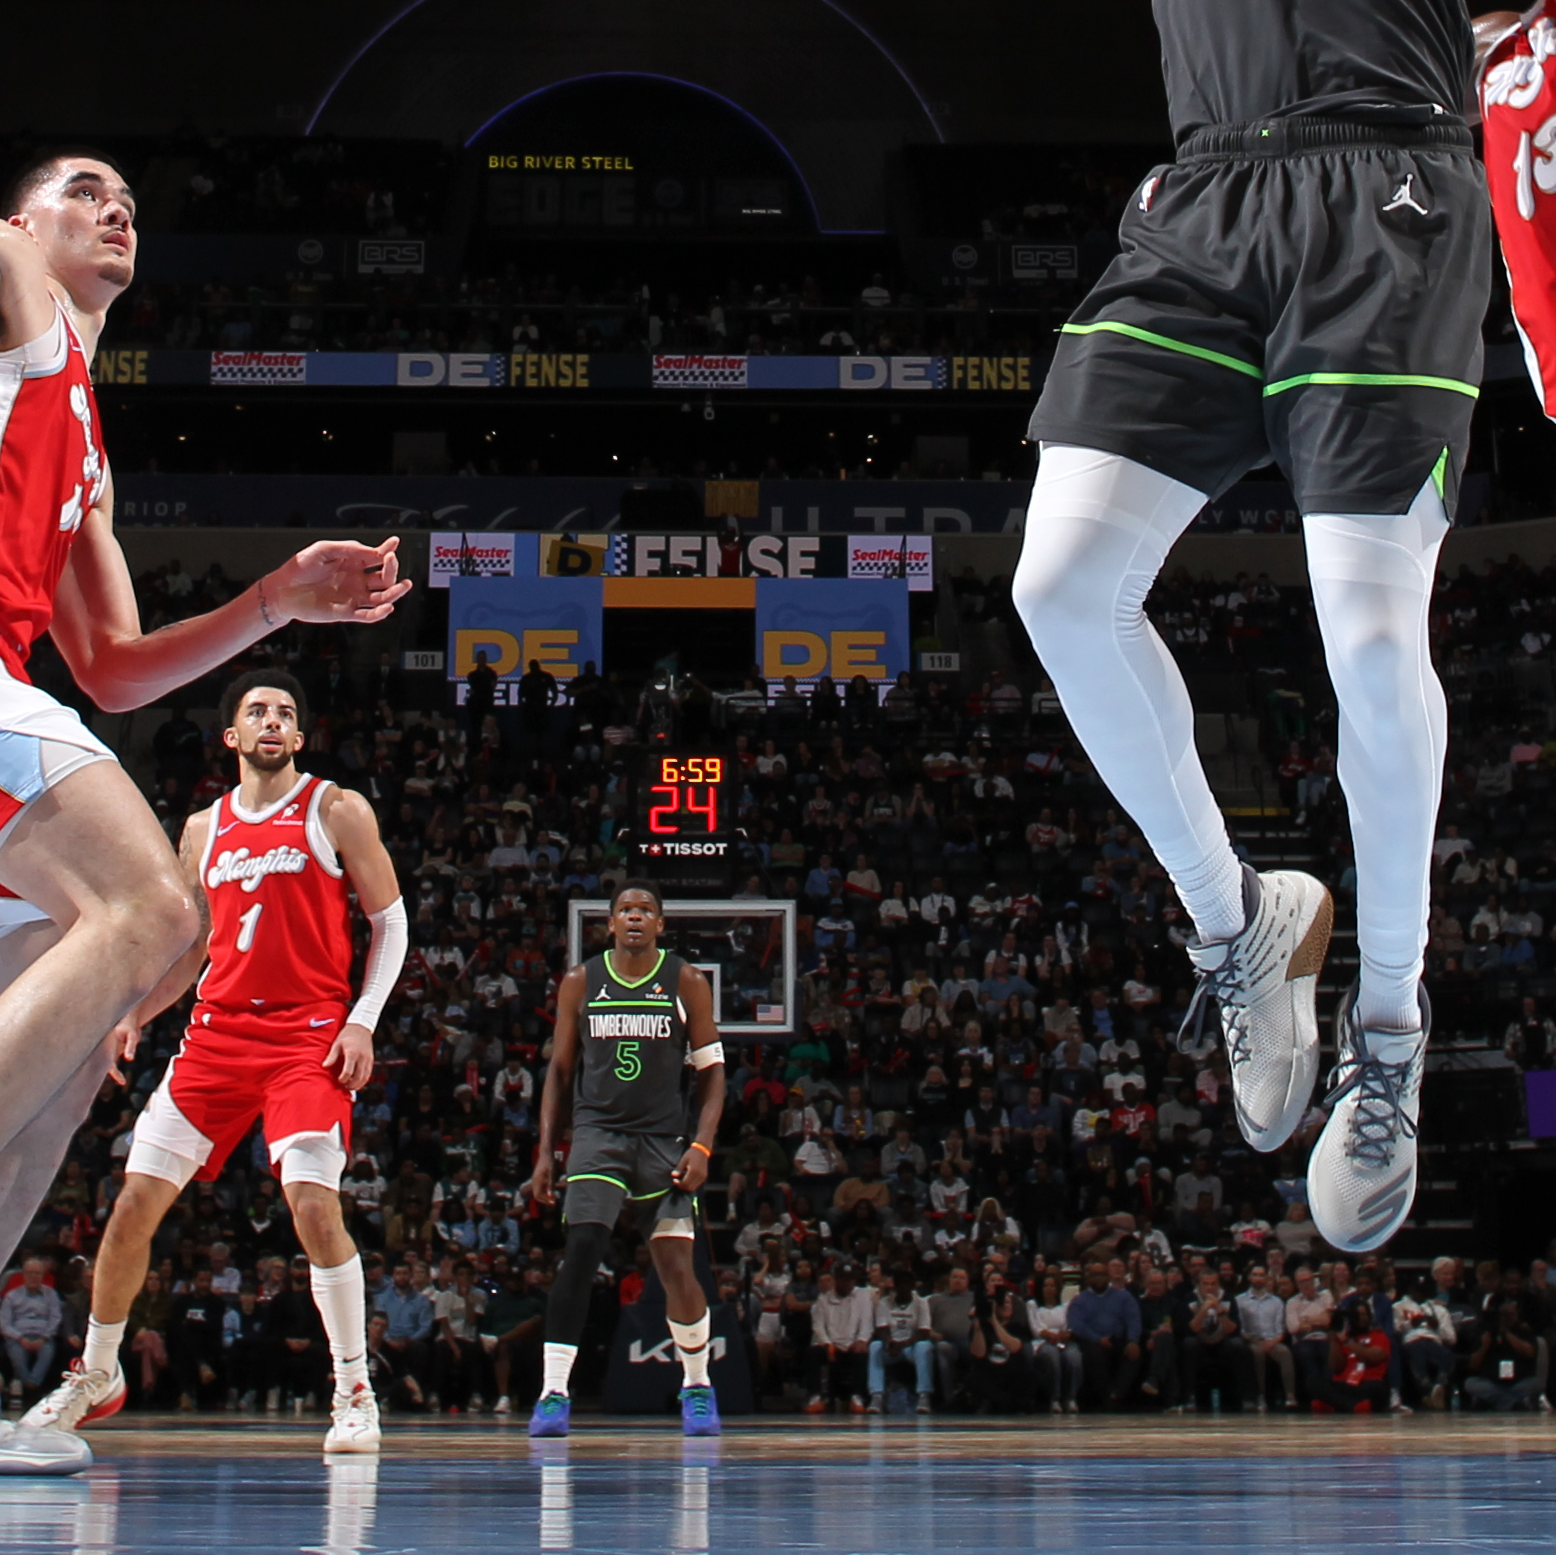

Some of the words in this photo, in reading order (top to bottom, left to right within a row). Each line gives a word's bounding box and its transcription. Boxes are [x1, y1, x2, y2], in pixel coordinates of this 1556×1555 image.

[488, 155, 518, 169] BIG
[524, 155, 576, 169] RIVER
[581, 156, 634, 170] STEEL
[365, 246, 419, 262] BRS
[1017, 251, 1073, 267] BRS
[212, 351, 304, 367] SealMaster
[398, 353, 490, 387] DE
[509, 353, 591, 388] FENSE
[652, 354, 746, 371] SealMaster
[840, 356, 933, 390] DE
[952, 356, 1032, 391] FENSE
[556, 545, 592, 575] D
[413, 653, 436, 667] 101
[455, 629, 579, 677] DE
[761, 631, 887, 678] DE
[928, 654, 953, 668] 118
[661, 758, 722, 784] 6:59
[649, 785, 718, 833] 24
[663, 843, 728, 856] TISSOT
[208, 845, 309, 893] Memphis
[237, 902, 263, 953] 1
[587, 1013, 673, 1041] TIMBERWOLVES
[613, 1040, 642, 1081] 5
